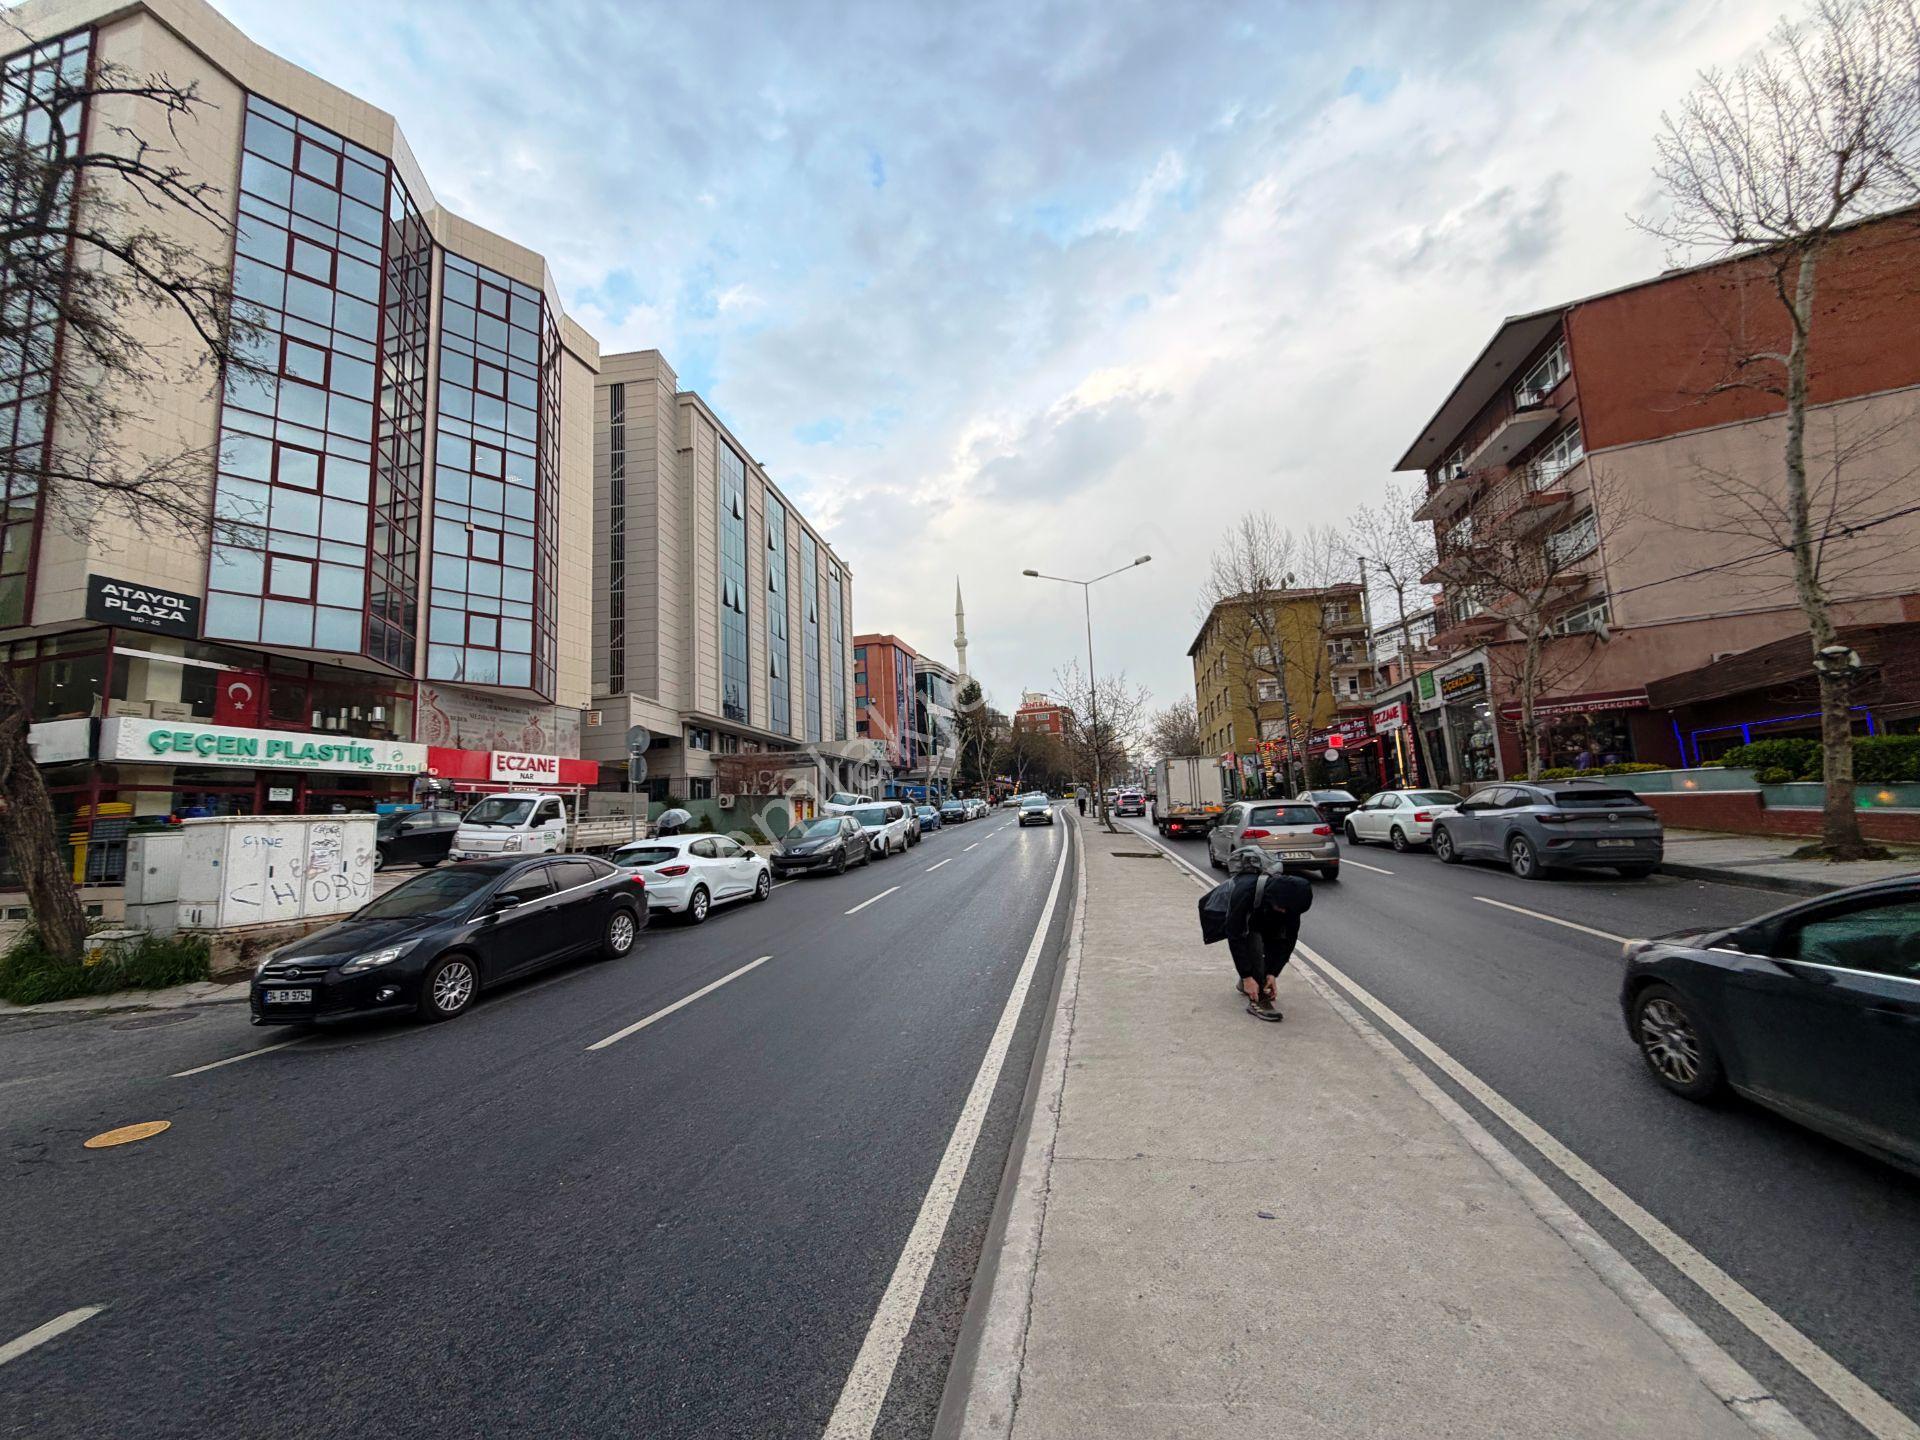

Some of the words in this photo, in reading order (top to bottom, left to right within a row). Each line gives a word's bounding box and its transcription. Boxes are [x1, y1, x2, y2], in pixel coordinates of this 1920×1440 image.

[101, 584, 191, 610] ATAYOL
[105, 597, 186, 622] PLAZA
[148, 729, 258, 757] ÇEÇEN
[266, 740, 374, 764] PLASTİK
[376, 763, 392, 771] 572
[497, 754, 556, 772] ECZANE
[267, 991, 277, 1001] 34
[291, 990, 311, 1001] 9754
